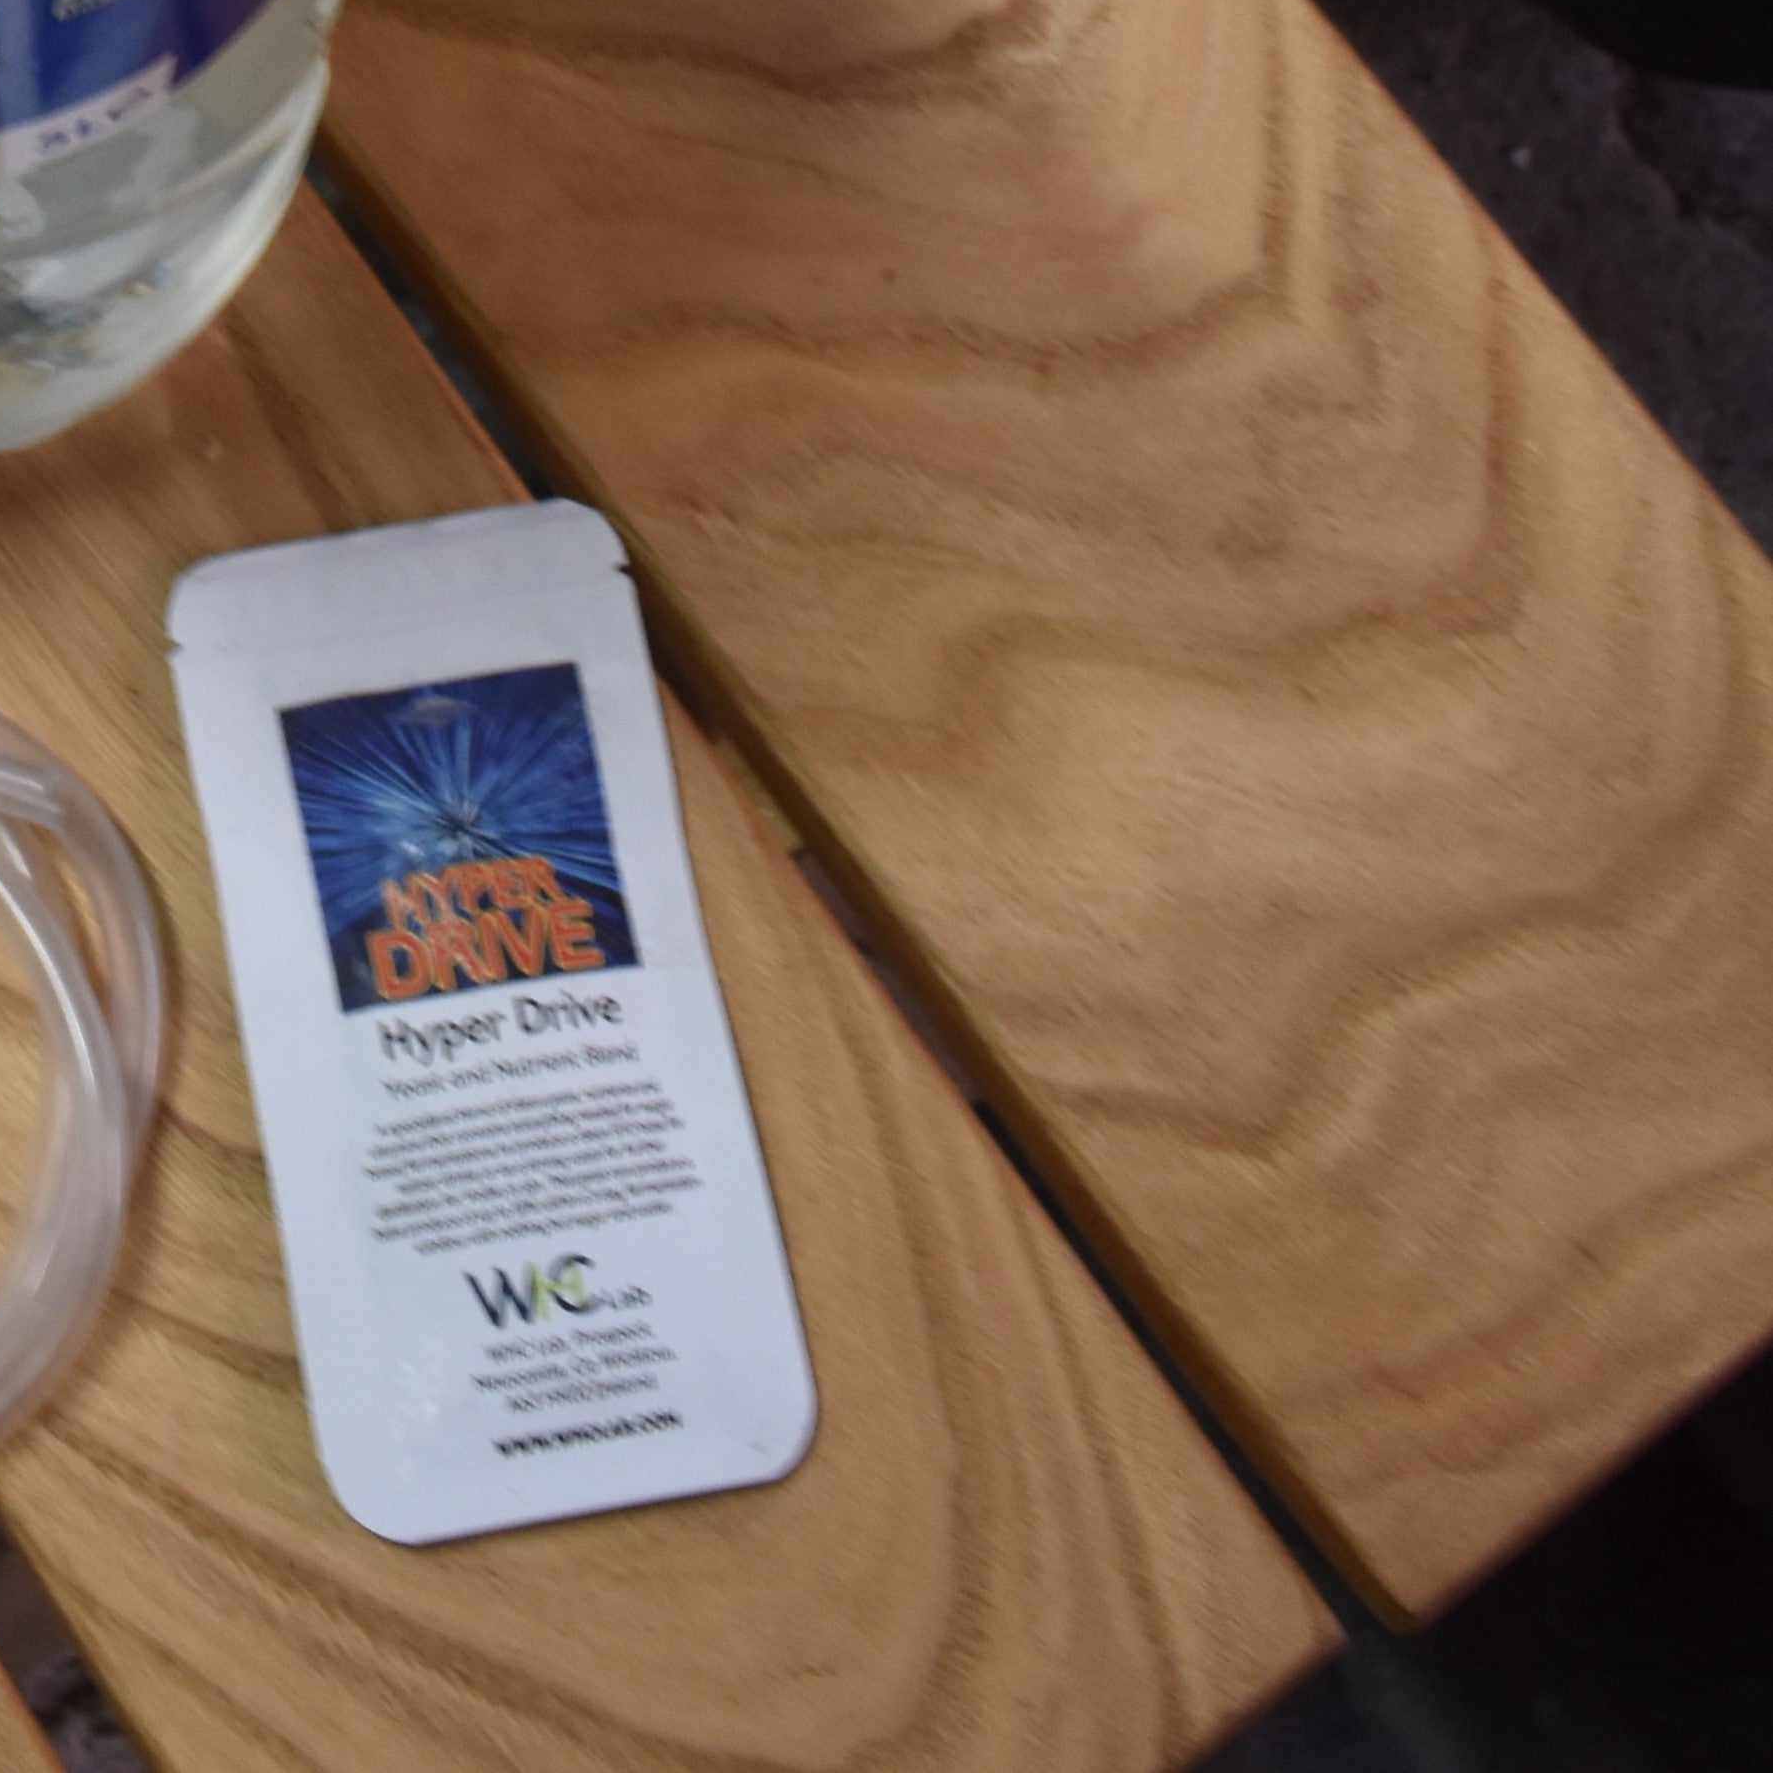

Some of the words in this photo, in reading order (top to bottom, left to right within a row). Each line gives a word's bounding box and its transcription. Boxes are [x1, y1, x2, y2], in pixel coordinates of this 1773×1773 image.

[380, 855, 567, 932] HYPER
[365, 896, 607, 1001] DRIVE
[376, 1010, 506, 1067] Hyper
[513, 990, 624, 1036] Drive
